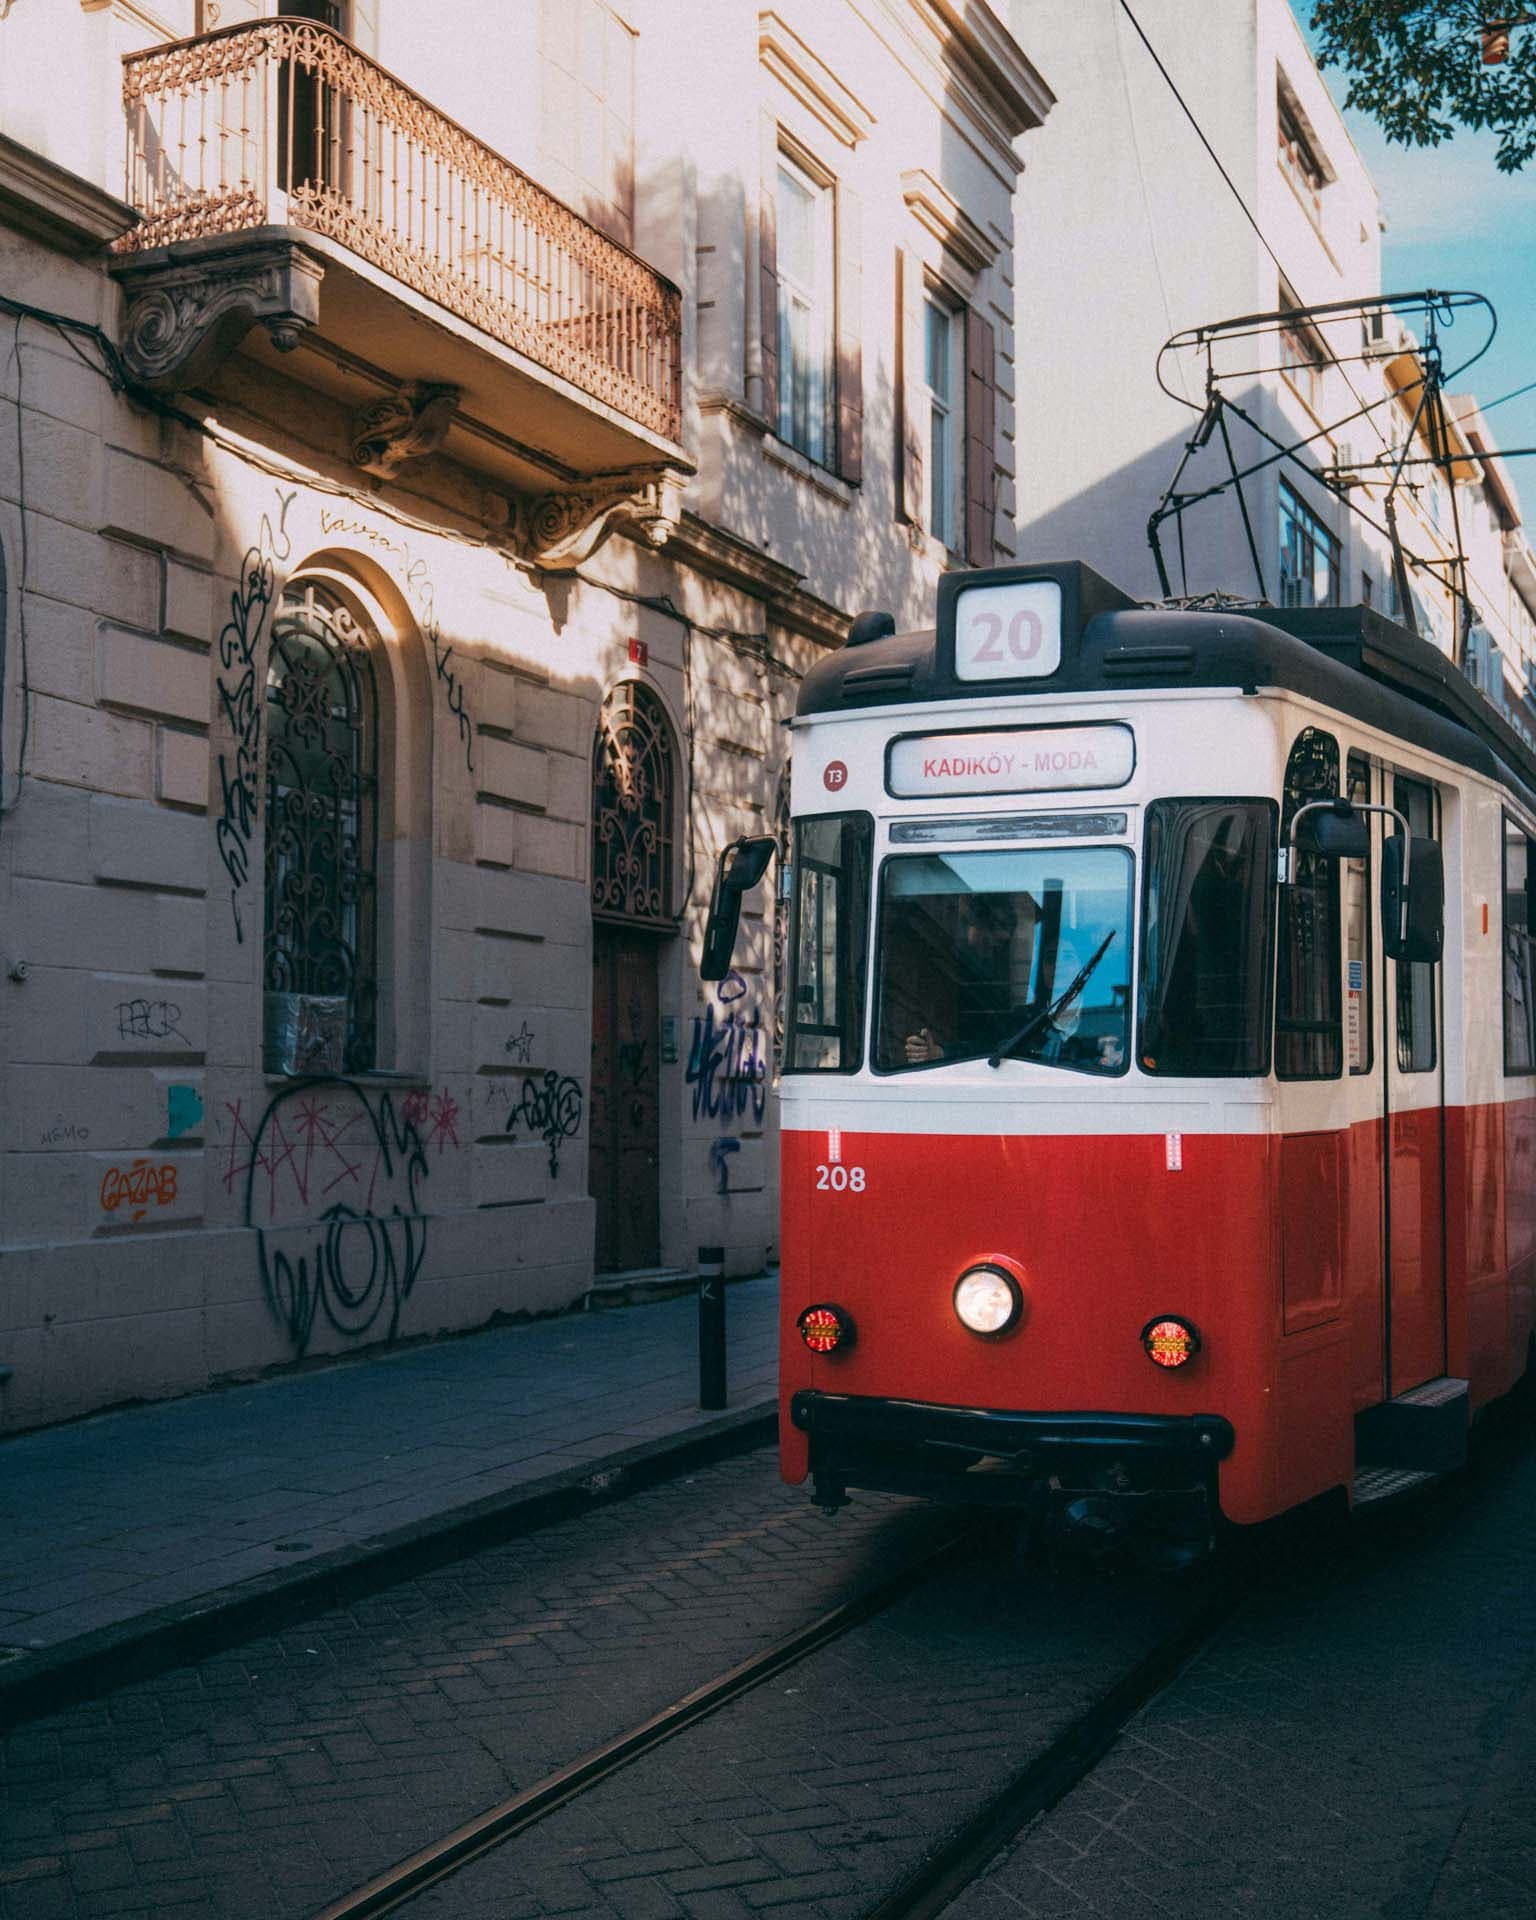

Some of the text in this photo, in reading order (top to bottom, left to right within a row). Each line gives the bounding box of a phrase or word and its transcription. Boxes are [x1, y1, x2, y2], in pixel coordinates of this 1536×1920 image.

[970, 610, 1042, 663] 20
[827, 769, 843, 784] T3
[923, 752, 1015, 778] KADIKÖY
[1034, 750, 1099, 772] MODA
[815, 1164, 866, 1193] 208
